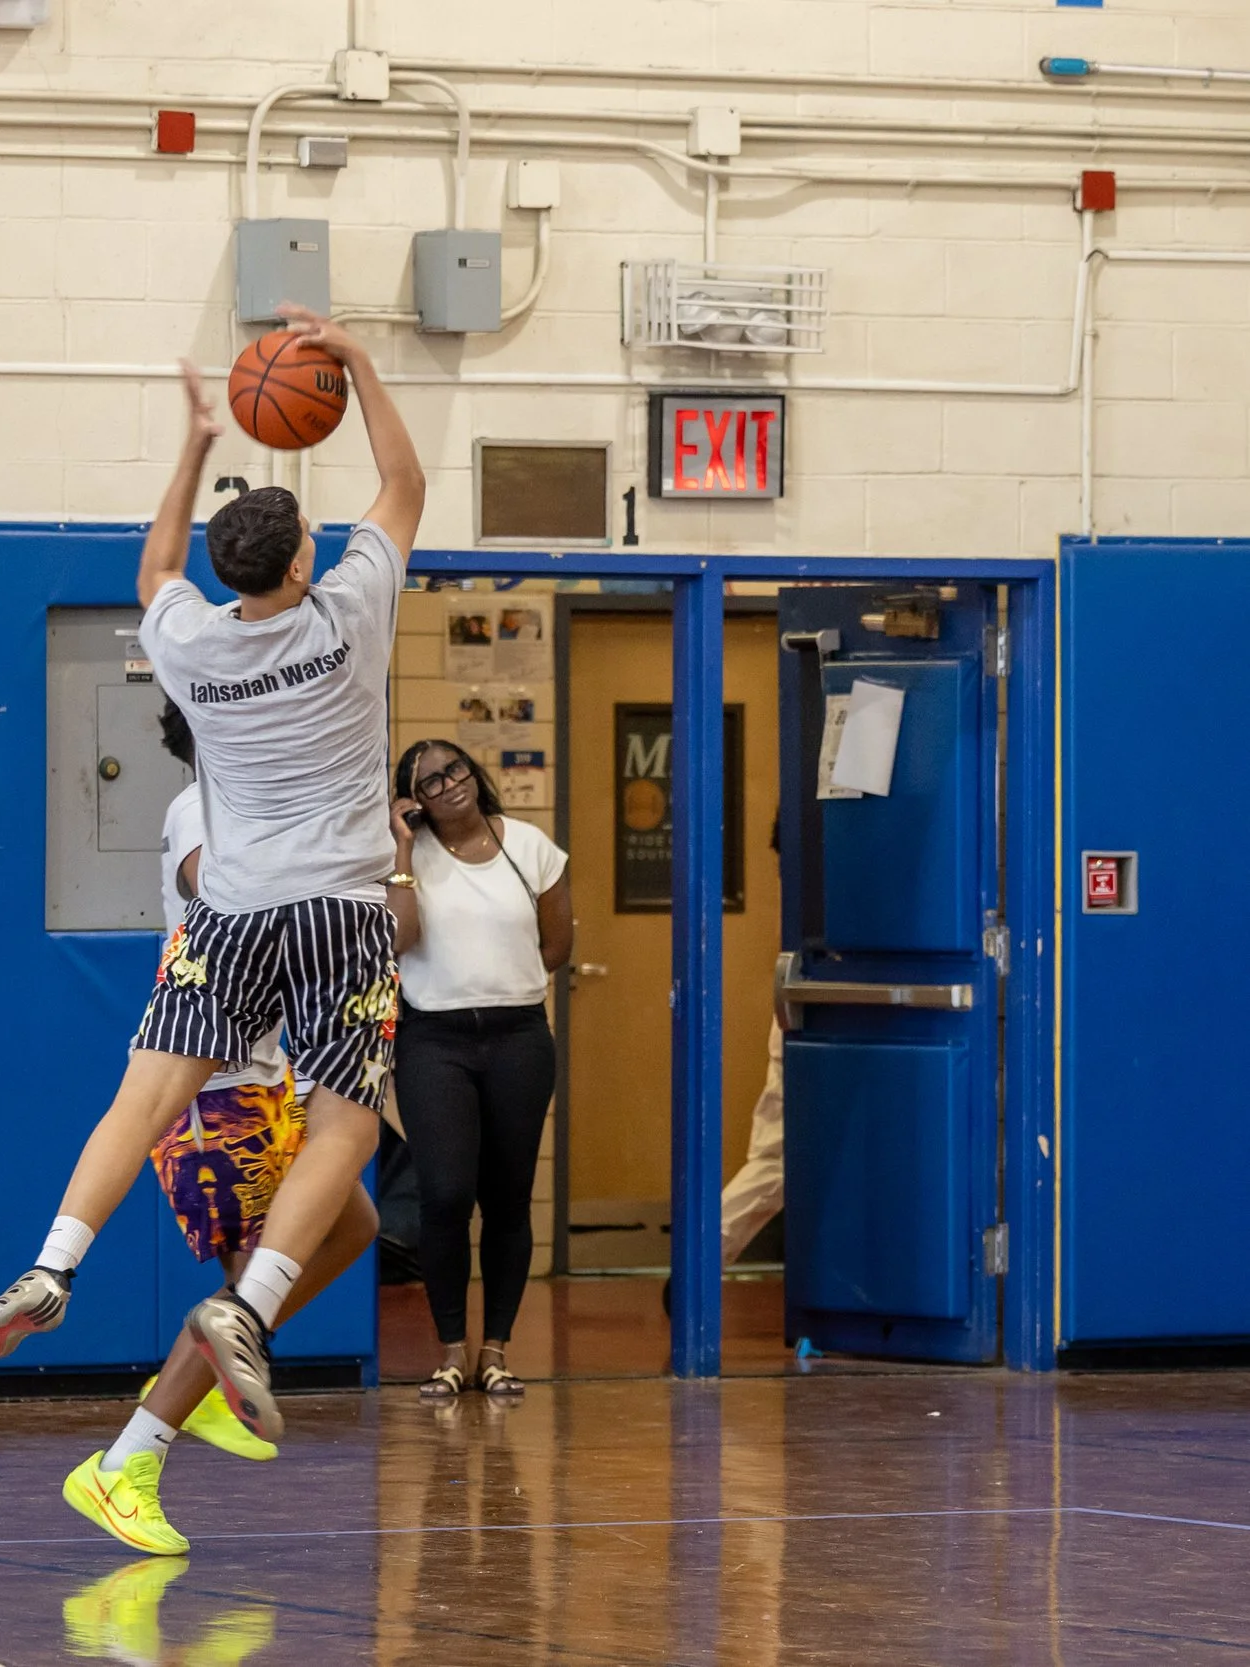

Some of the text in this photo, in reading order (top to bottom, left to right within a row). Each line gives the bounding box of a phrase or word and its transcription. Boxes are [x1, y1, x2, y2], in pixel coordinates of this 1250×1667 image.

[673, 409, 776, 491] EXIT
[622, 486, 639, 546] 1
[623, 733, 673, 778] M
